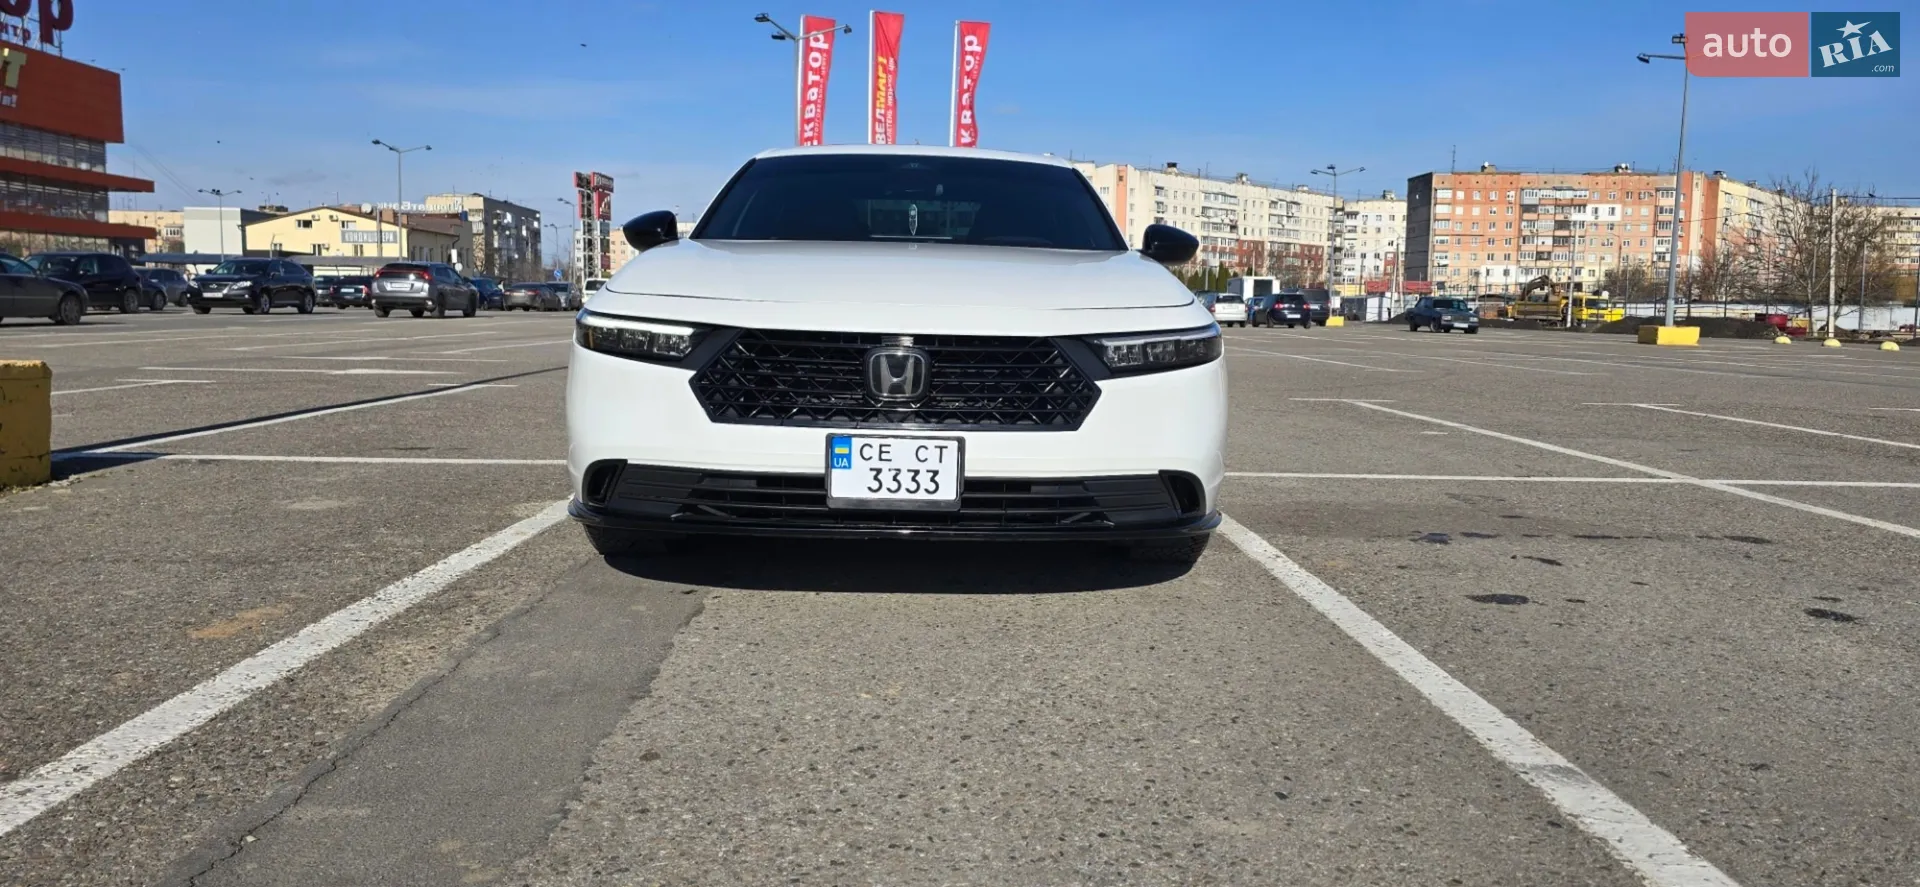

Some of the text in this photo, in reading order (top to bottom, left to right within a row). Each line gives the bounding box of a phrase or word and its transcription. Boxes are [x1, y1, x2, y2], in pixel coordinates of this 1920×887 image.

[834, 458, 849, 467] UA
[859, 443, 948, 464] CE CT
[867, 468, 940, 494] 3333
